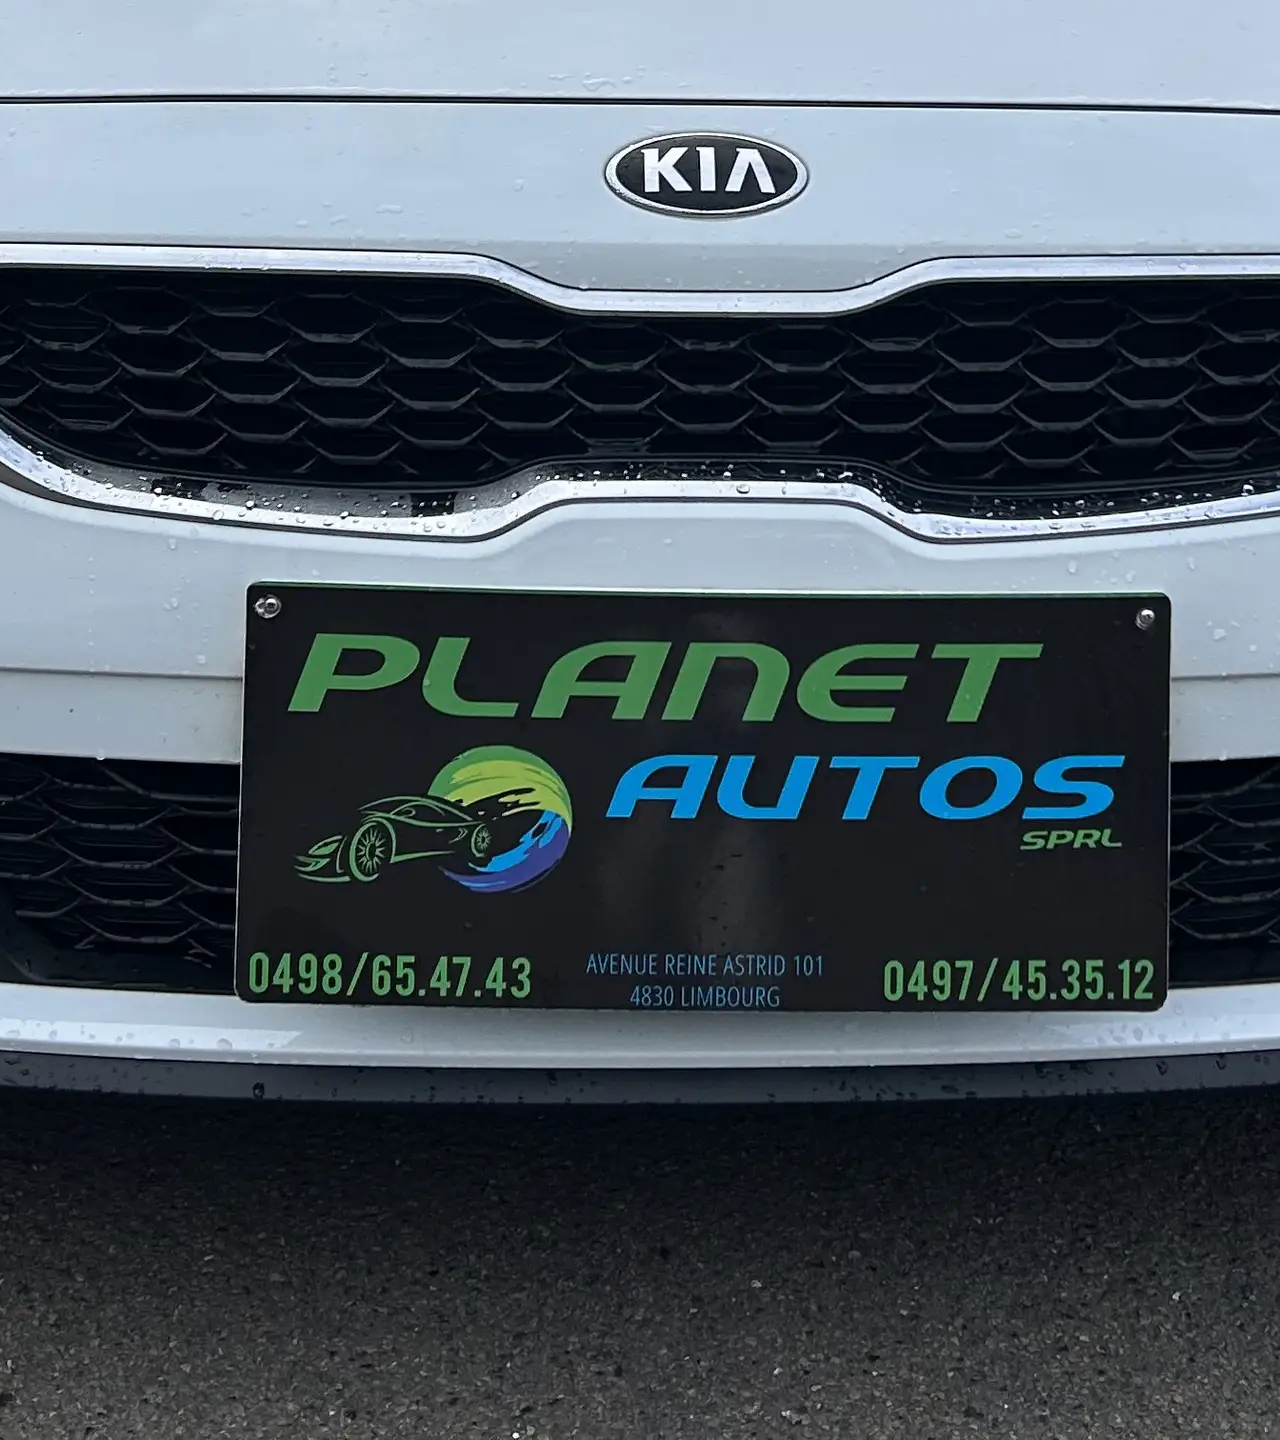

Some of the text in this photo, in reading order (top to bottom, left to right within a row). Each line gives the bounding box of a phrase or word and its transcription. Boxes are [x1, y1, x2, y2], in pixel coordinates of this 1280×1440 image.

[640, 146, 776, 194] KIA
[287, 632, 1044, 724] PLANET
[605, 753, 1125, 821] AUTOS
[1020, 828, 1122, 850] SPRL
[248, 951, 532, 999] 0498/65.47.43
[585, 953, 823, 977] AVENUE REINE ASTRID 101
[883, 957, 1155, 1002] 0497/45.35.12
[630, 985, 781, 1008] 4830 LIMBOURG
